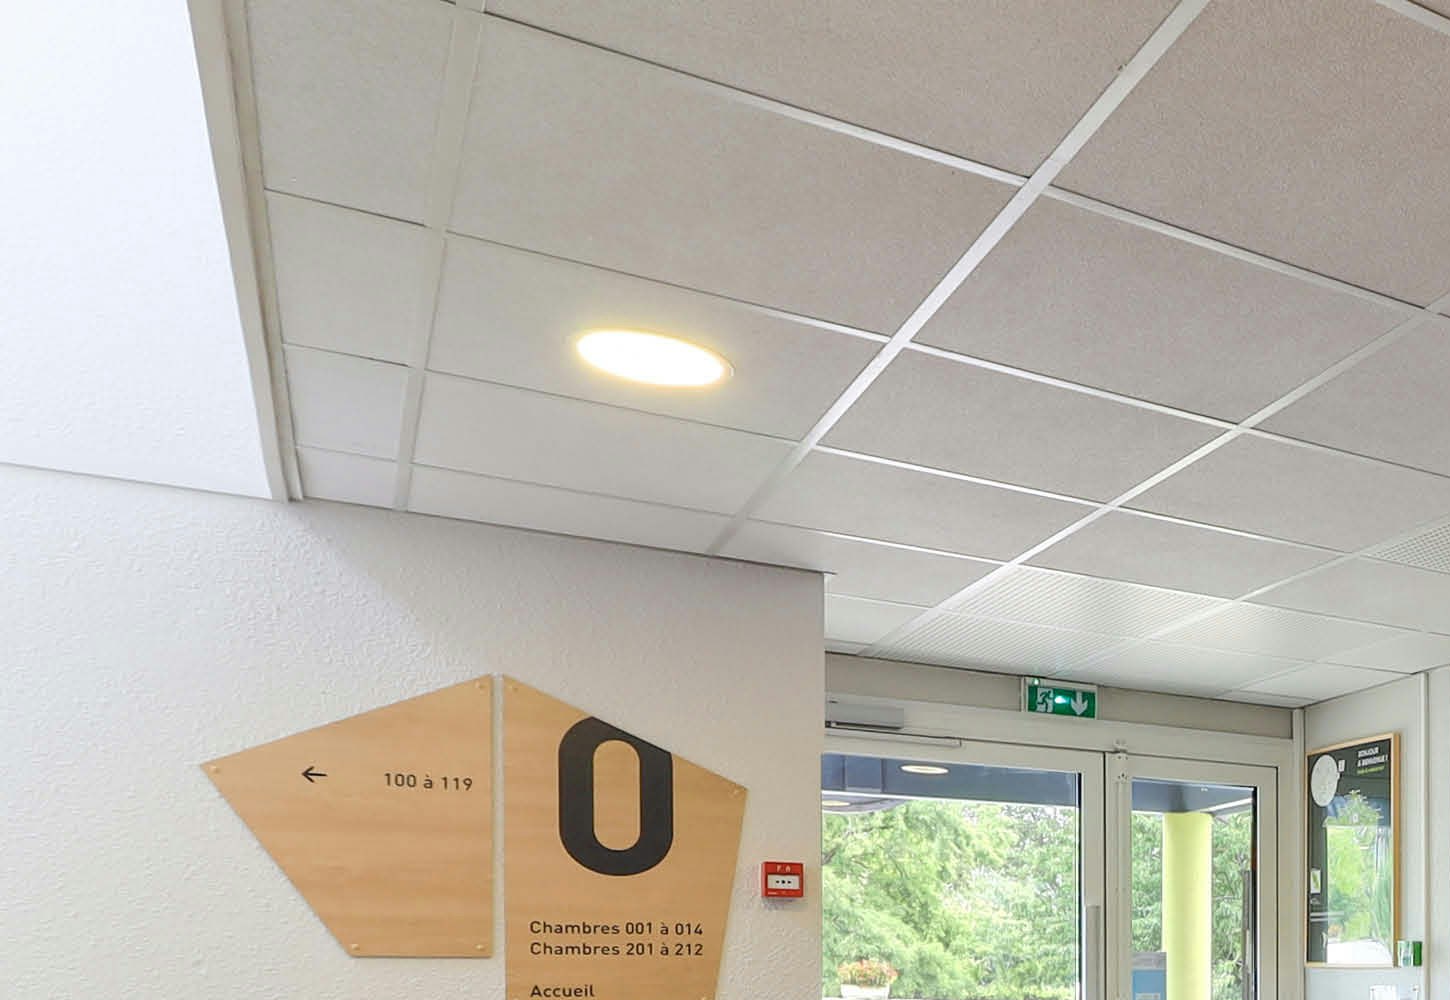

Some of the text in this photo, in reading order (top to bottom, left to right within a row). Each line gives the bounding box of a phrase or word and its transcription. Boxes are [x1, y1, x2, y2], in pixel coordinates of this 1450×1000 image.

[384, 773, 473, 791] 100 à 119
[529, 920, 704, 936] Chambres 001 à 014
[529, 942, 704, 956] Chambres 201 à 212
[530, 984, 595, 998] Accueil
